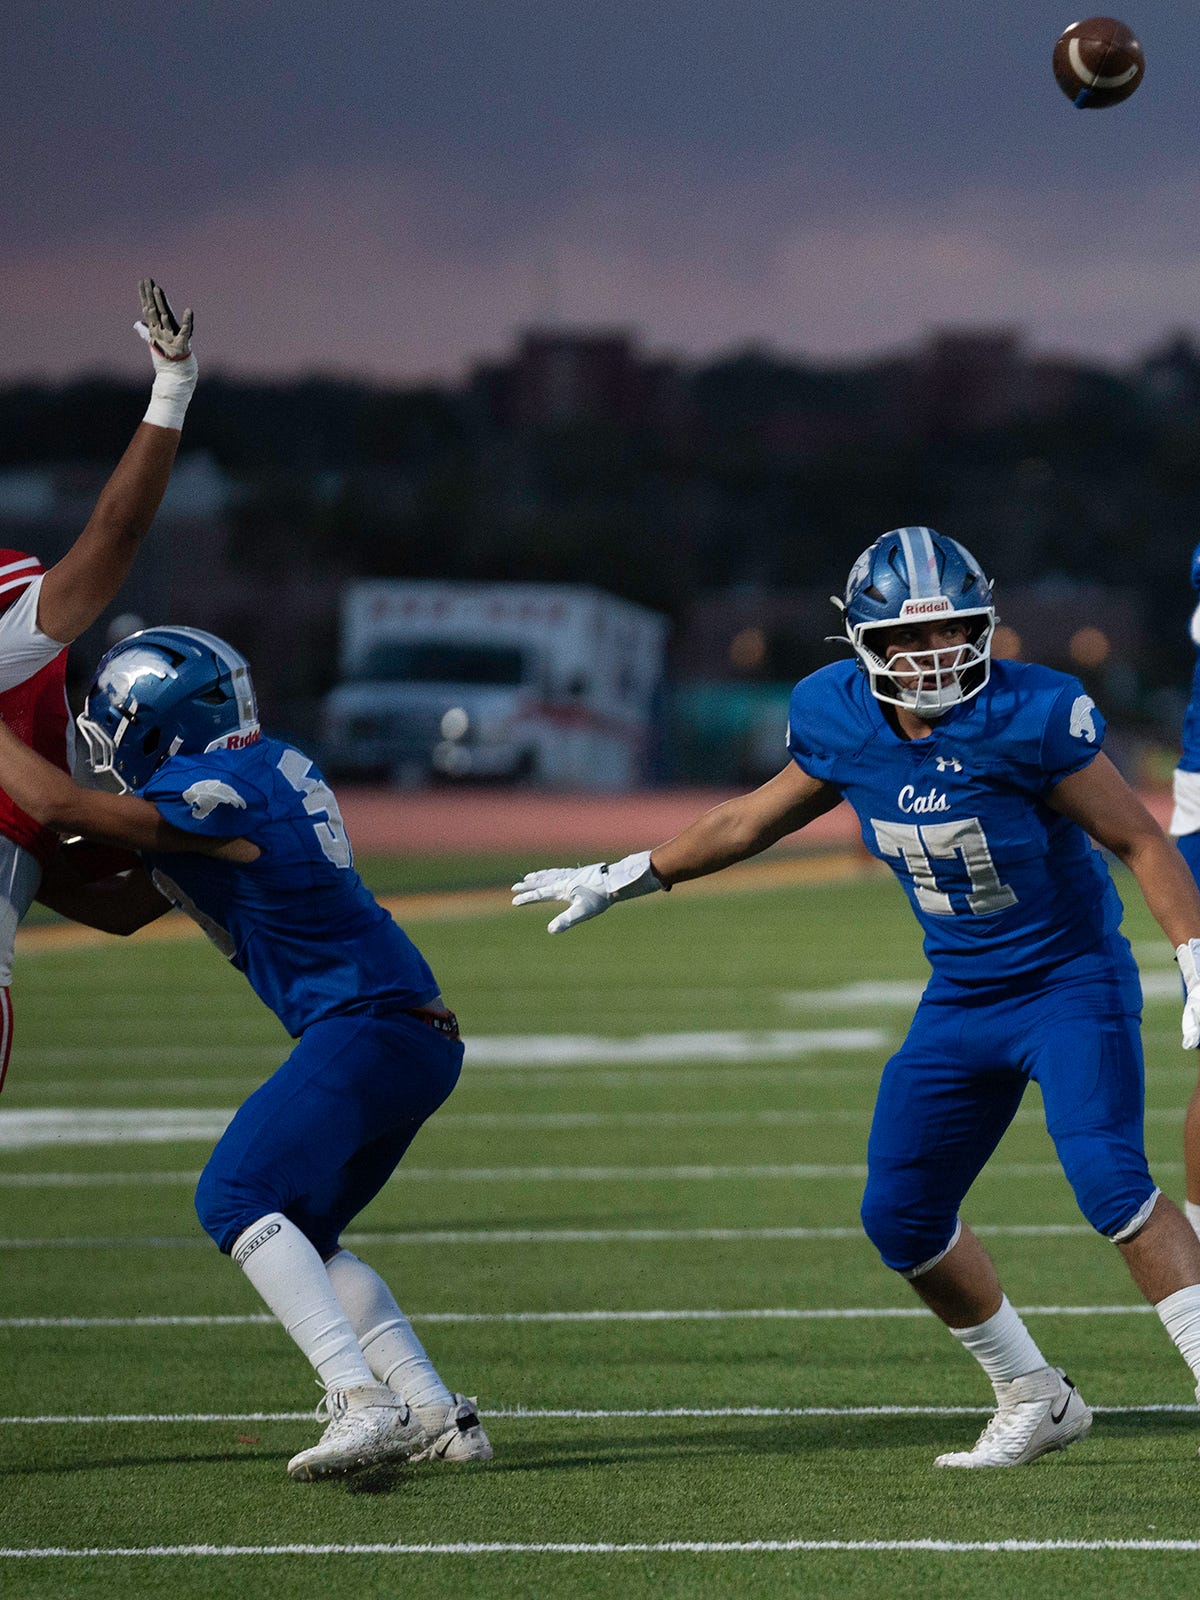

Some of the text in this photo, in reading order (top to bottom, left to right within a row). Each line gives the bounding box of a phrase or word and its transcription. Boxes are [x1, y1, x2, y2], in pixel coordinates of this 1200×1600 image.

[906, 601, 949, 615] Riddell
[227, 729, 260, 749] Ridd
[898, 785, 951, 814] Cats
[870, 817, 1019, 916] 77
